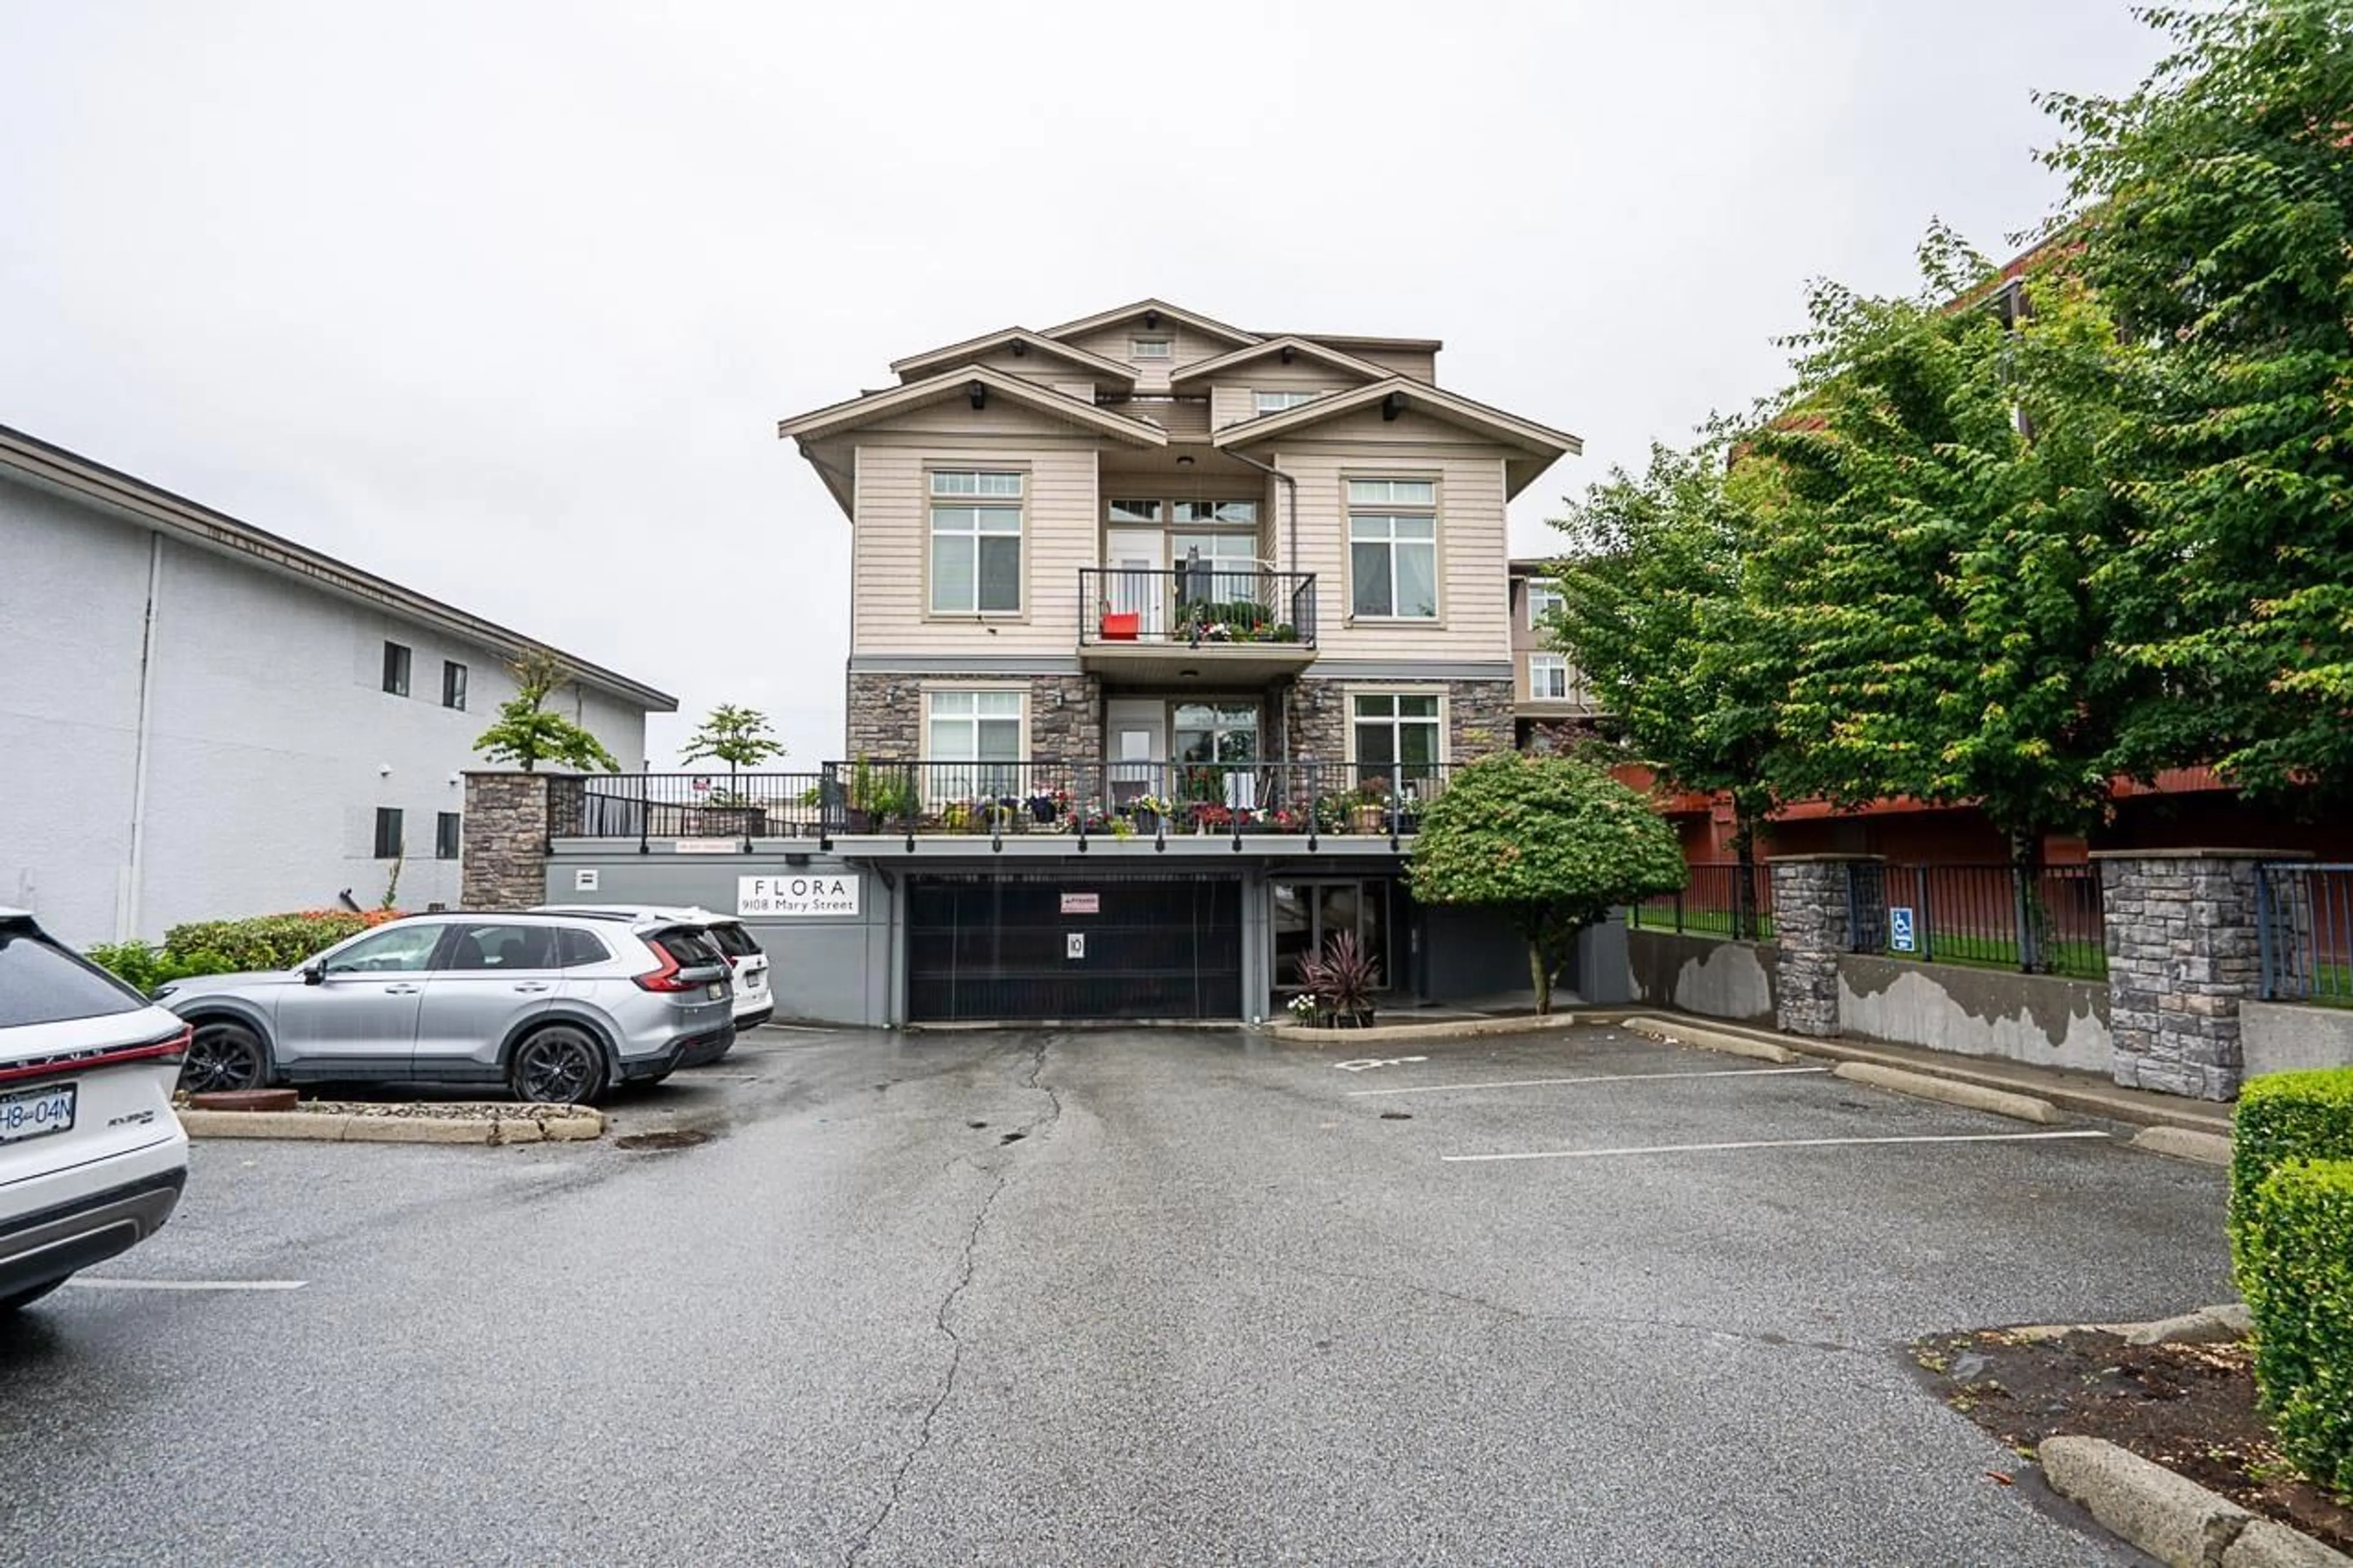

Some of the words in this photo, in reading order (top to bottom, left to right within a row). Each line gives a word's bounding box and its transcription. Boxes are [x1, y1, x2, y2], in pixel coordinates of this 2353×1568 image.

[754, 879, 845, 896] FLORA
[742, 900, 769, 911] 9108
[775, 899, 808, 912] Mary
[813, 898, 854, 911] Street
